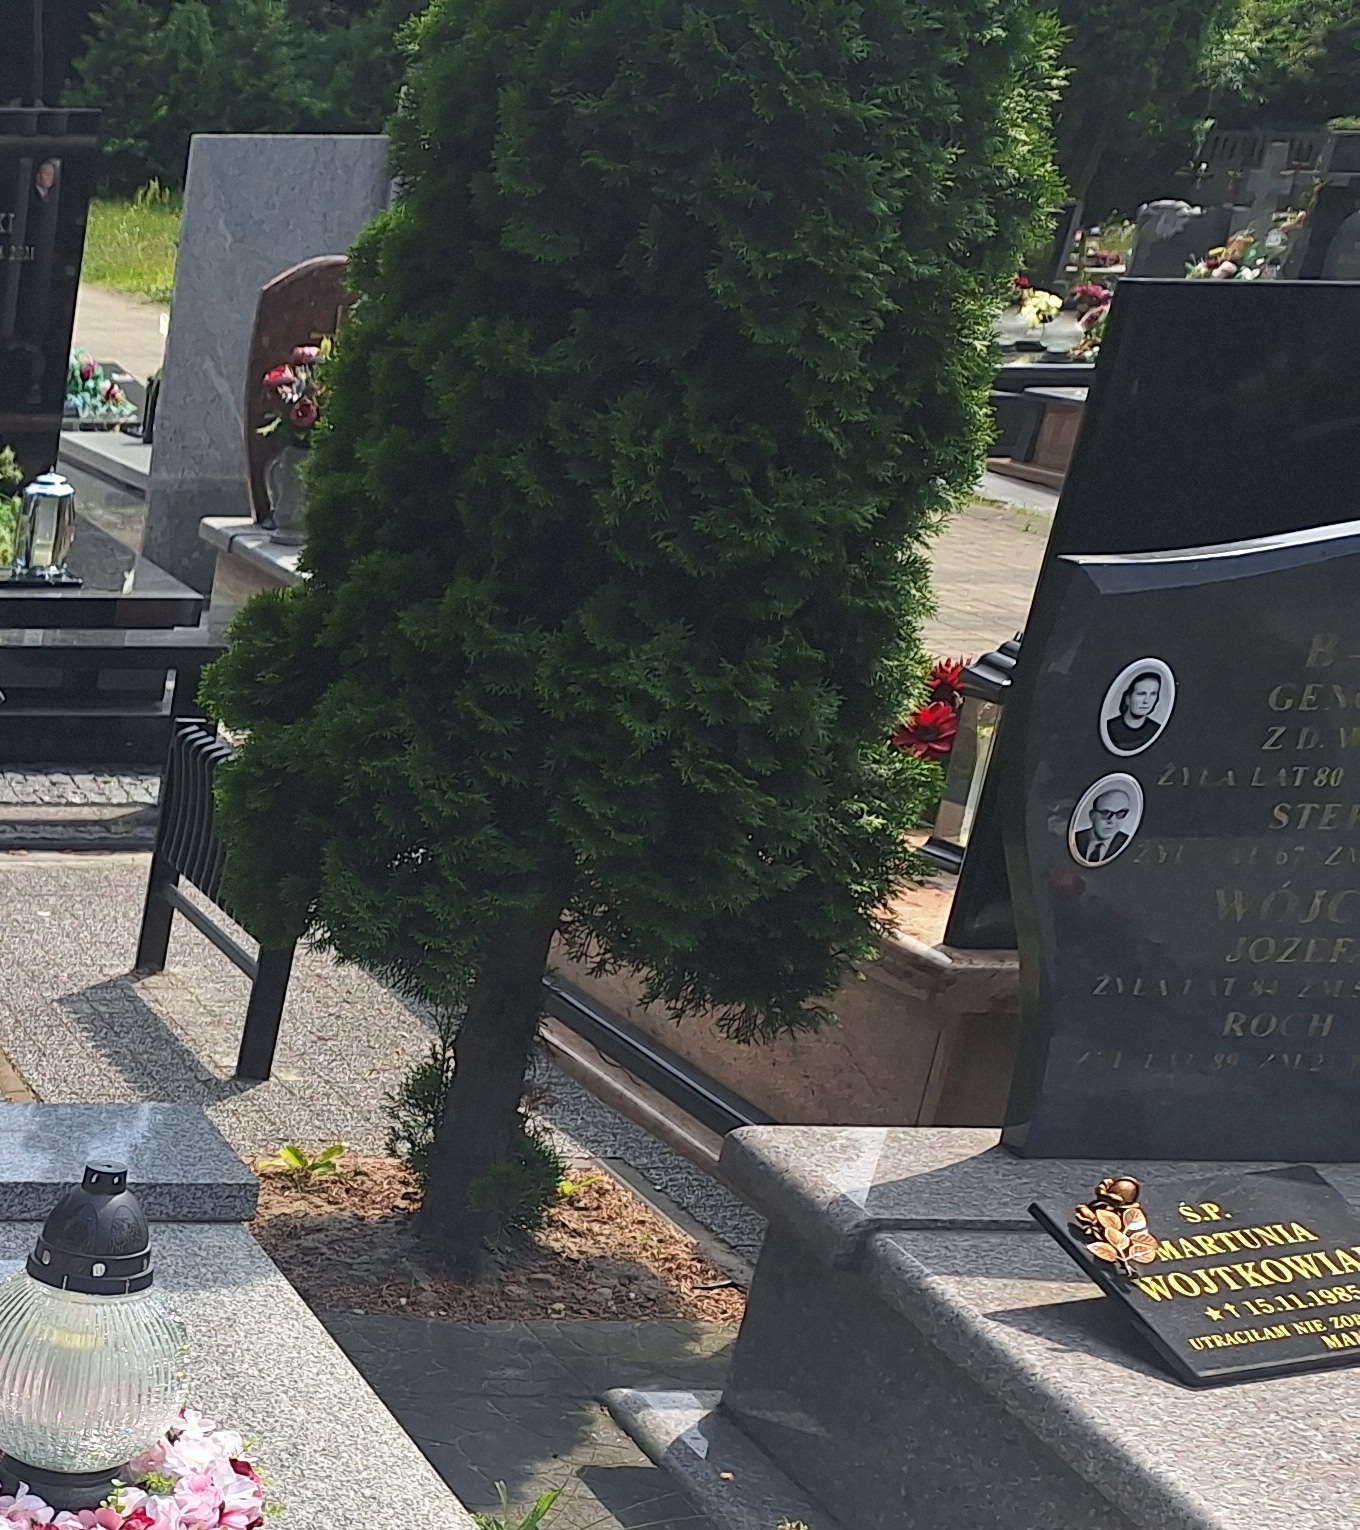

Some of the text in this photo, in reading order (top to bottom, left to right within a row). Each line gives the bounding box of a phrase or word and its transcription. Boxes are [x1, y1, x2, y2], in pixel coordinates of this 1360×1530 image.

[1311, 766, 1347, 788] 80
[1215, 879, 1360, 925] WÓJC
[1221, 1010, 1337, 1038] ROCH
[1177, 1200, 1234, 1224] Ś.P.
[1156, 1222, 1319, 1262] MARTUNIA
[1188, 1325, 1291, 1351] UTRACIŁAM
[1291, 1317, 1329, 1337] NIE
